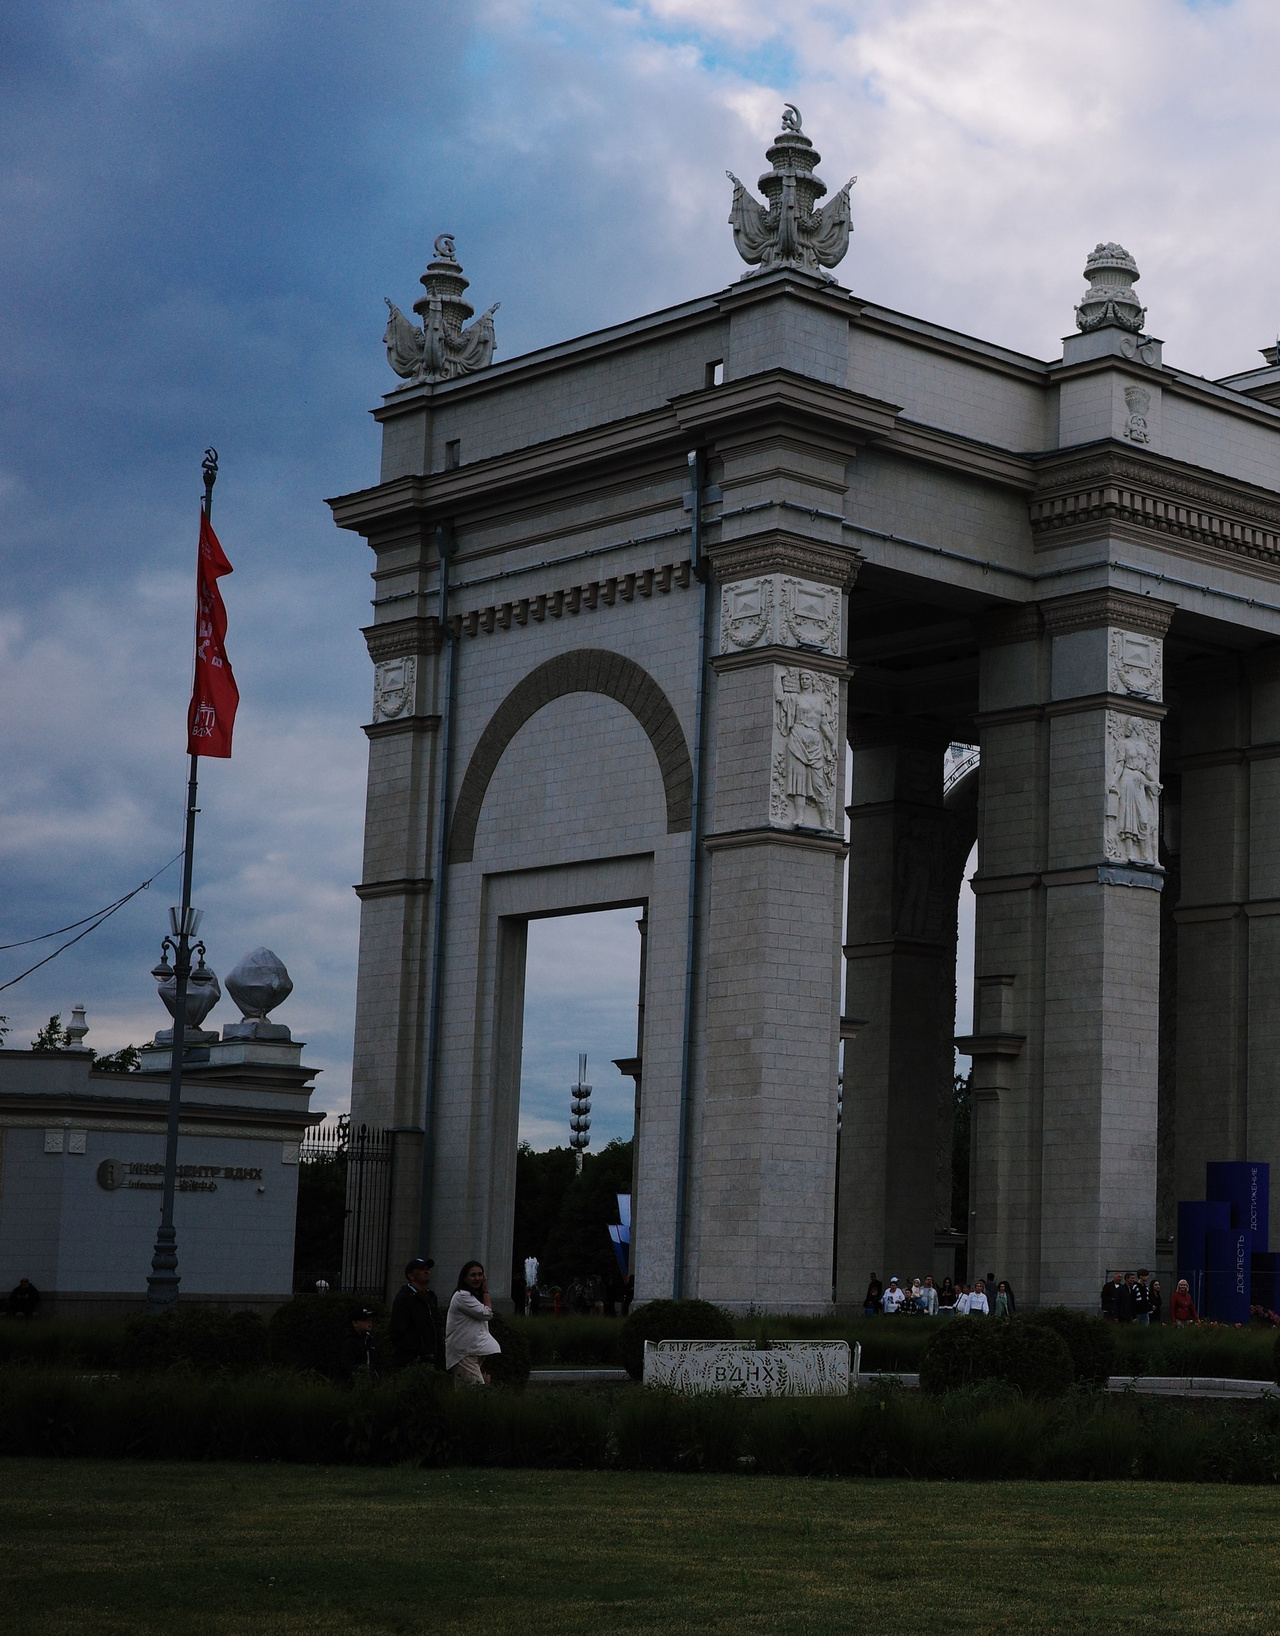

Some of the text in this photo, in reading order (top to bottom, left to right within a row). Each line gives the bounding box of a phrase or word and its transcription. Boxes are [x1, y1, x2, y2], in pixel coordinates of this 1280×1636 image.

[1250, 1167, 1258, 1231] ДОСТИЖЕНИЕ
[1236, 1234, 1245, 1295] ДОБЛЕСТЬ
[715, 1366, 775, 1382] ВДНХ
